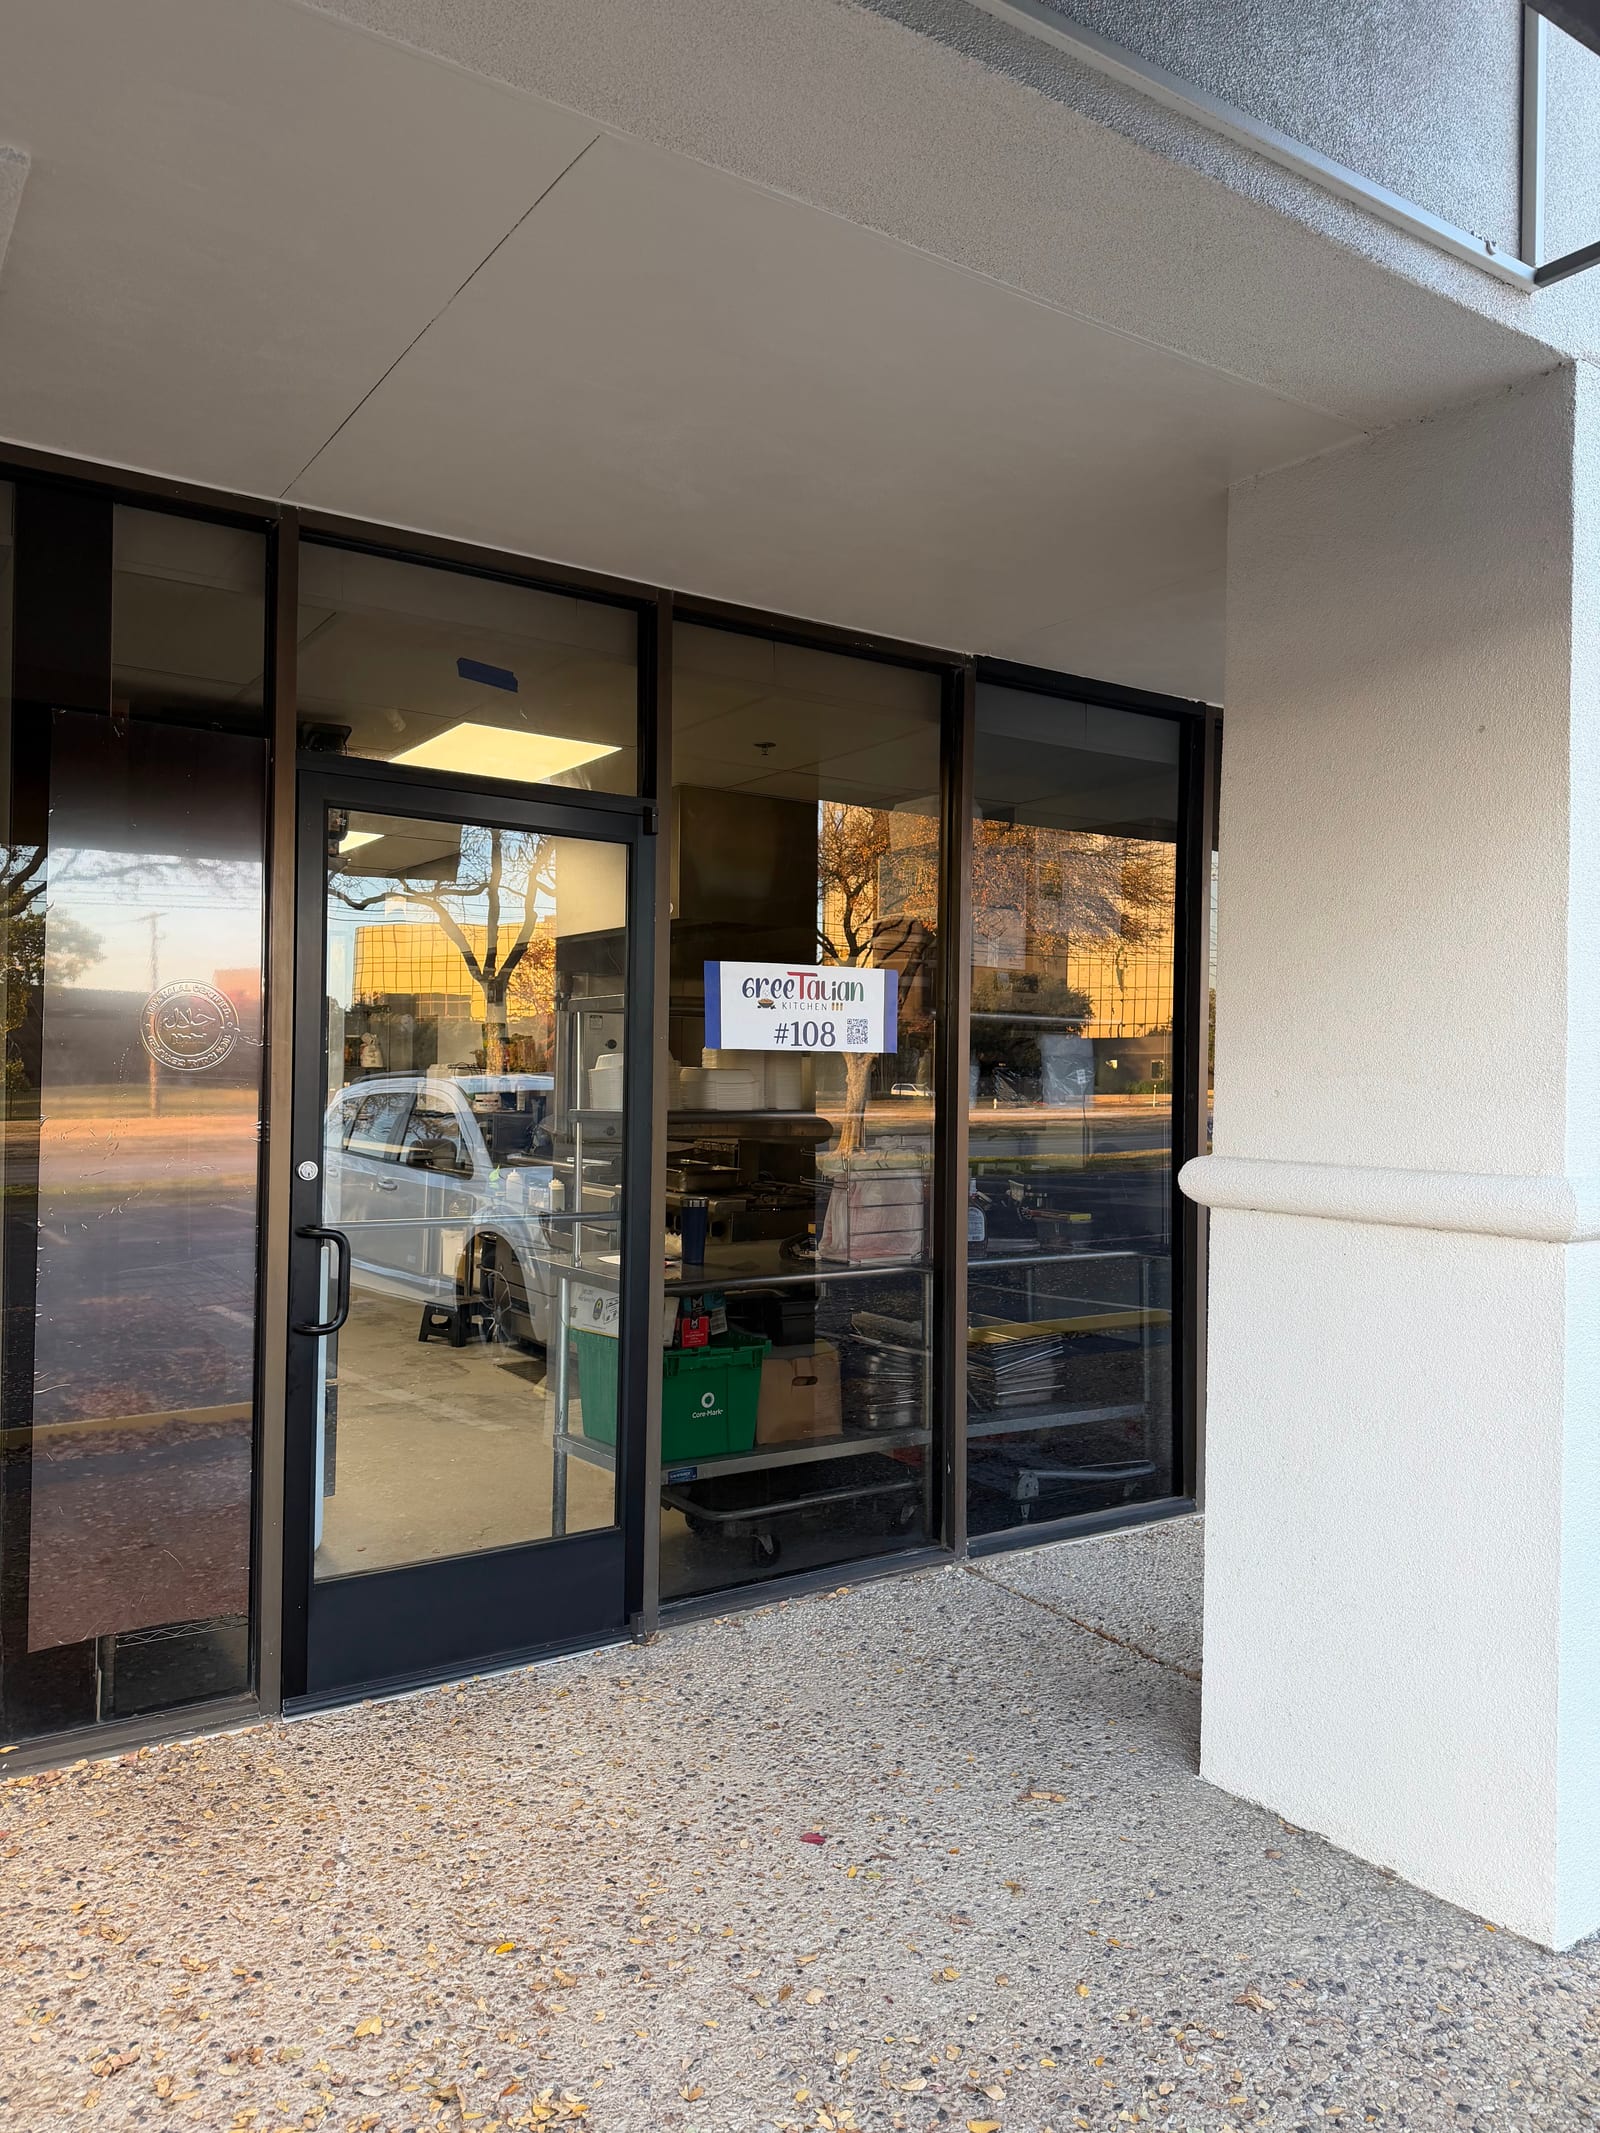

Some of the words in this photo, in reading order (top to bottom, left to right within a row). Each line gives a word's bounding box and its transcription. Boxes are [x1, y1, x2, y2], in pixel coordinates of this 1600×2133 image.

[782, 1001, 828, 1011] KITCHEN
[773, 1020, 836, 1047] #108
[692, 1408, 722, 1419] Core-Mark
